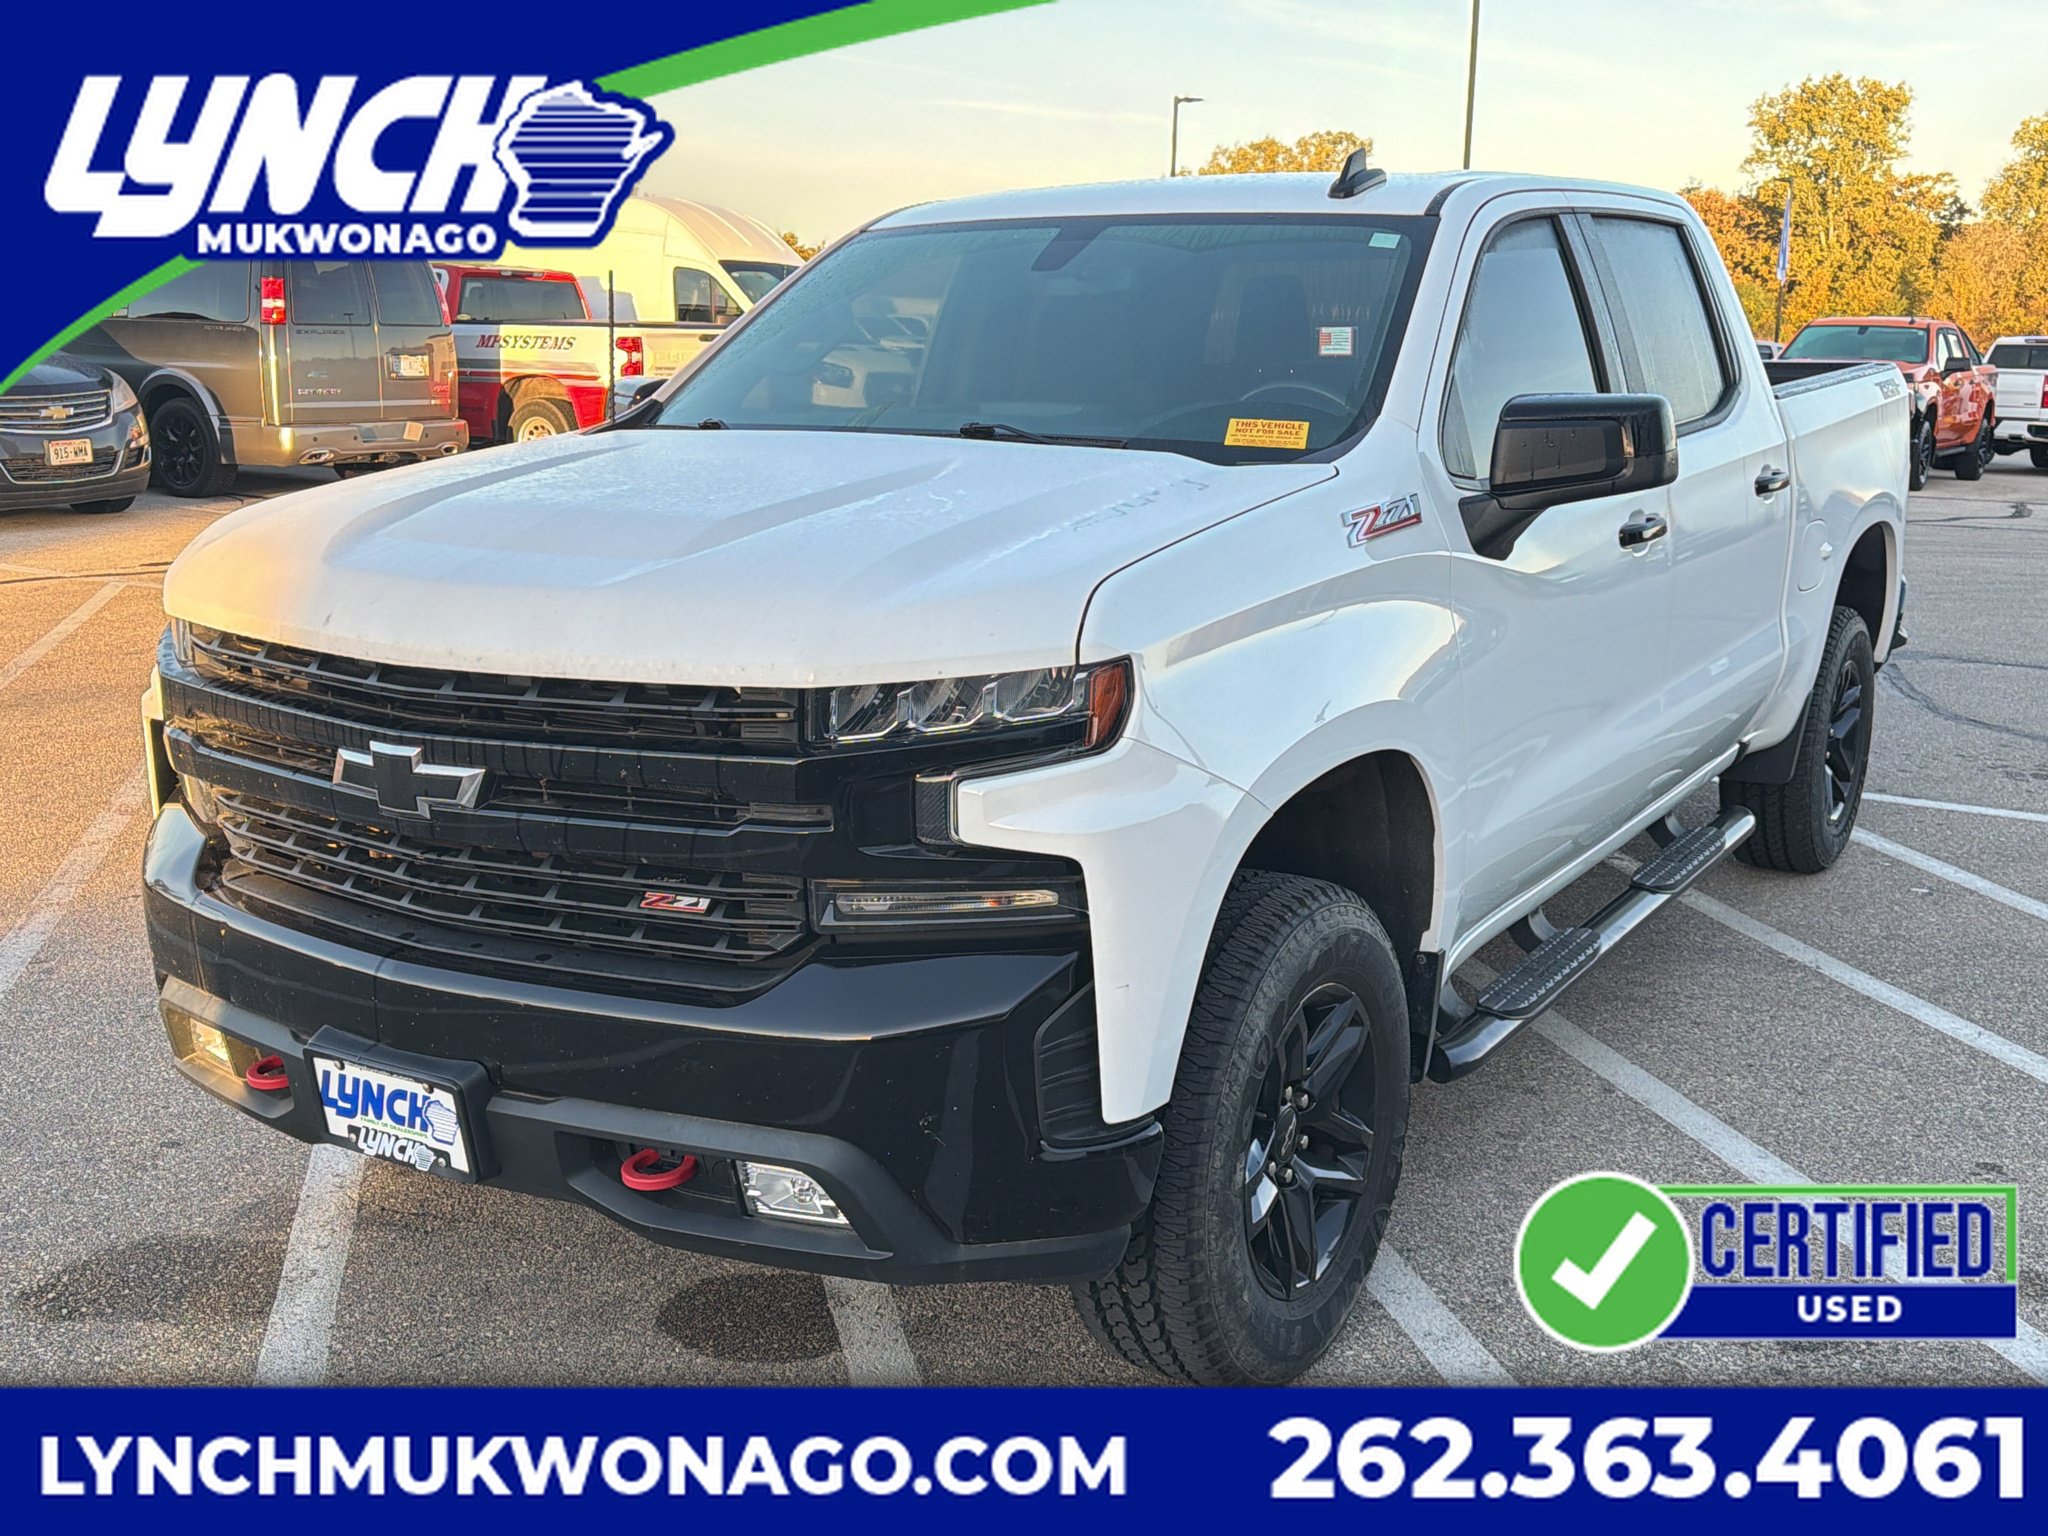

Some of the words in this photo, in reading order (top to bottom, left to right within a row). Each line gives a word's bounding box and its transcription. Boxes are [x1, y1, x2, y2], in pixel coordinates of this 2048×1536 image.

[1234, 420, 1258, 428] THIS
[1260, 421, 1305, 430] VEHICLE
[1341, 492, 1423, 549] Z71
[639, 891, 712, 914] Z71
[319, 1069, 431, 1133] LYNCH
[357, 1126, 420, 1165] LYNCH
